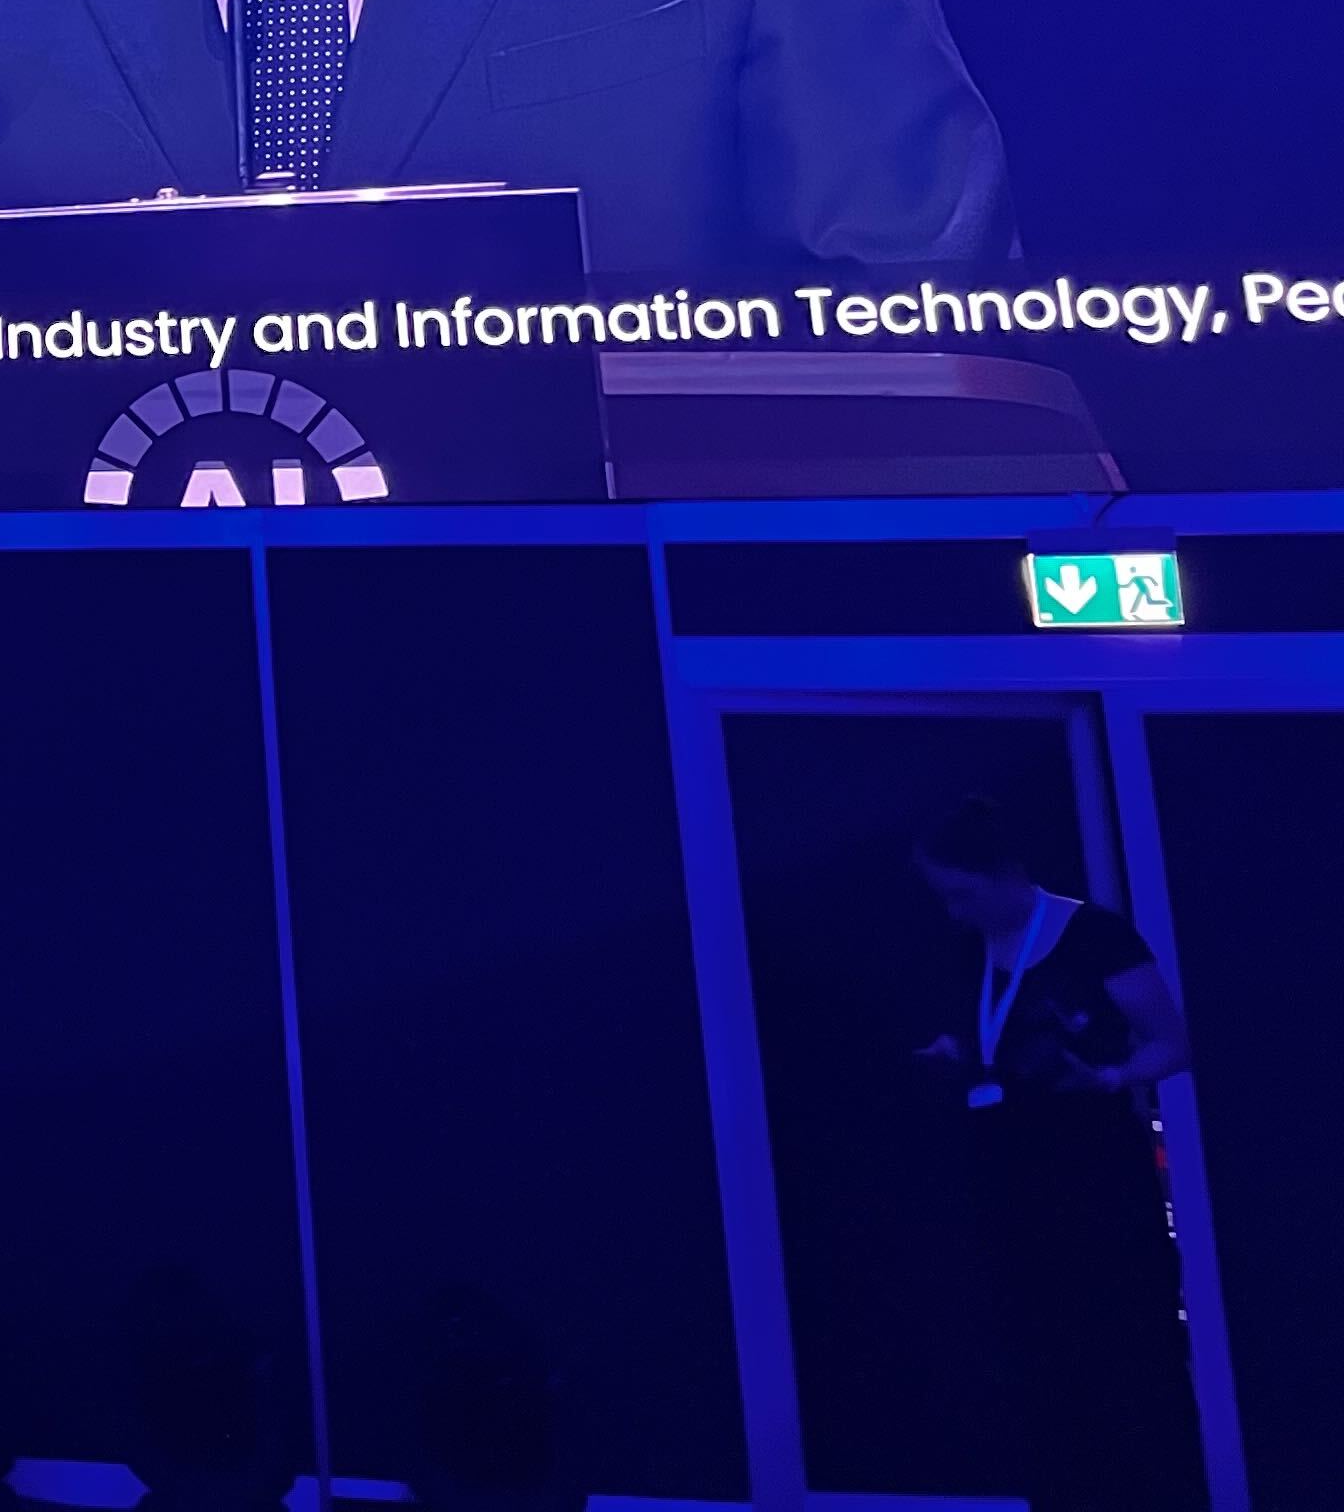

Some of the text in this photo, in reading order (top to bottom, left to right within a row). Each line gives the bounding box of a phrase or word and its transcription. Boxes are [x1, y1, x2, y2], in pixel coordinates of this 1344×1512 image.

[252, 299, 378, 354] and
[394, 288, 781, 349] Information
[793, 276, 1228, 345] Technology,
[1241, 272, 1344, 325] Pe
